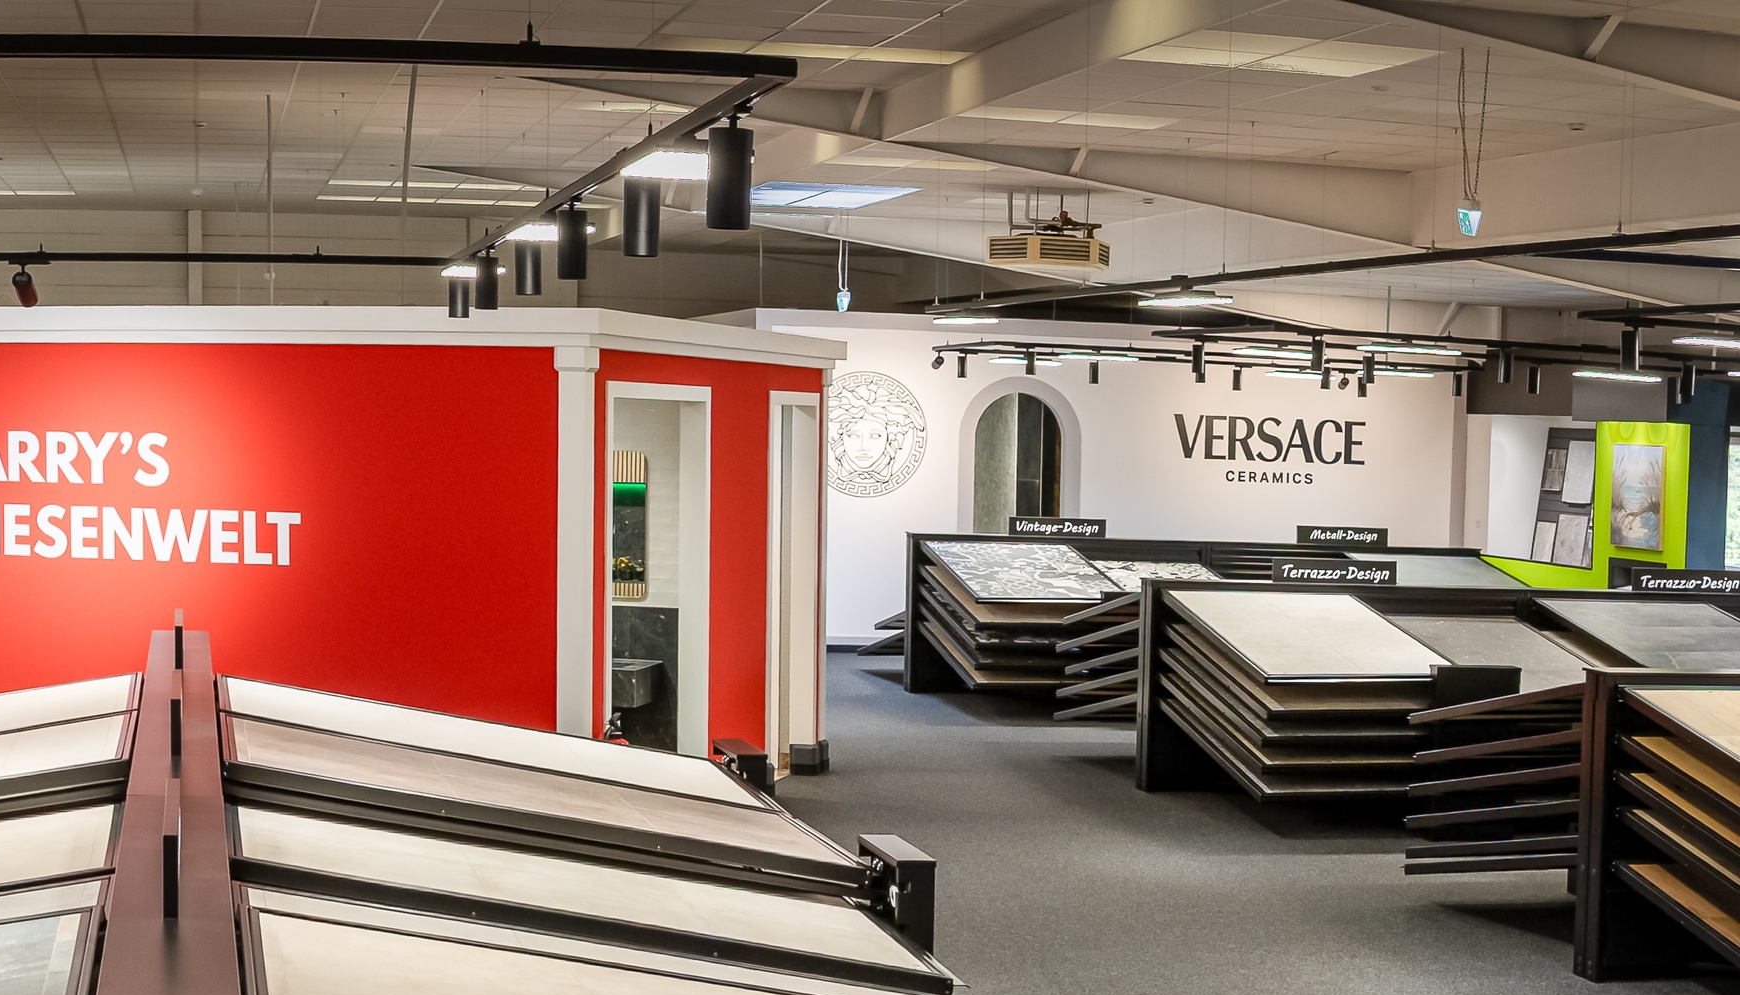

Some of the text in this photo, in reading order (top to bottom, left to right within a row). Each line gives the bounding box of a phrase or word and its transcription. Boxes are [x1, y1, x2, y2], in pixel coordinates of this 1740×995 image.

[1173, 413, 1367, 466] VERSACE
[1225, 470, 1314, 485] CERAMICS
[1015, 520, 1099, 536] Vintage-Design
[1309, 529, 1378, 543] Metall-Design
[1281, 564, 1390, 584] Terrazzo-Design
